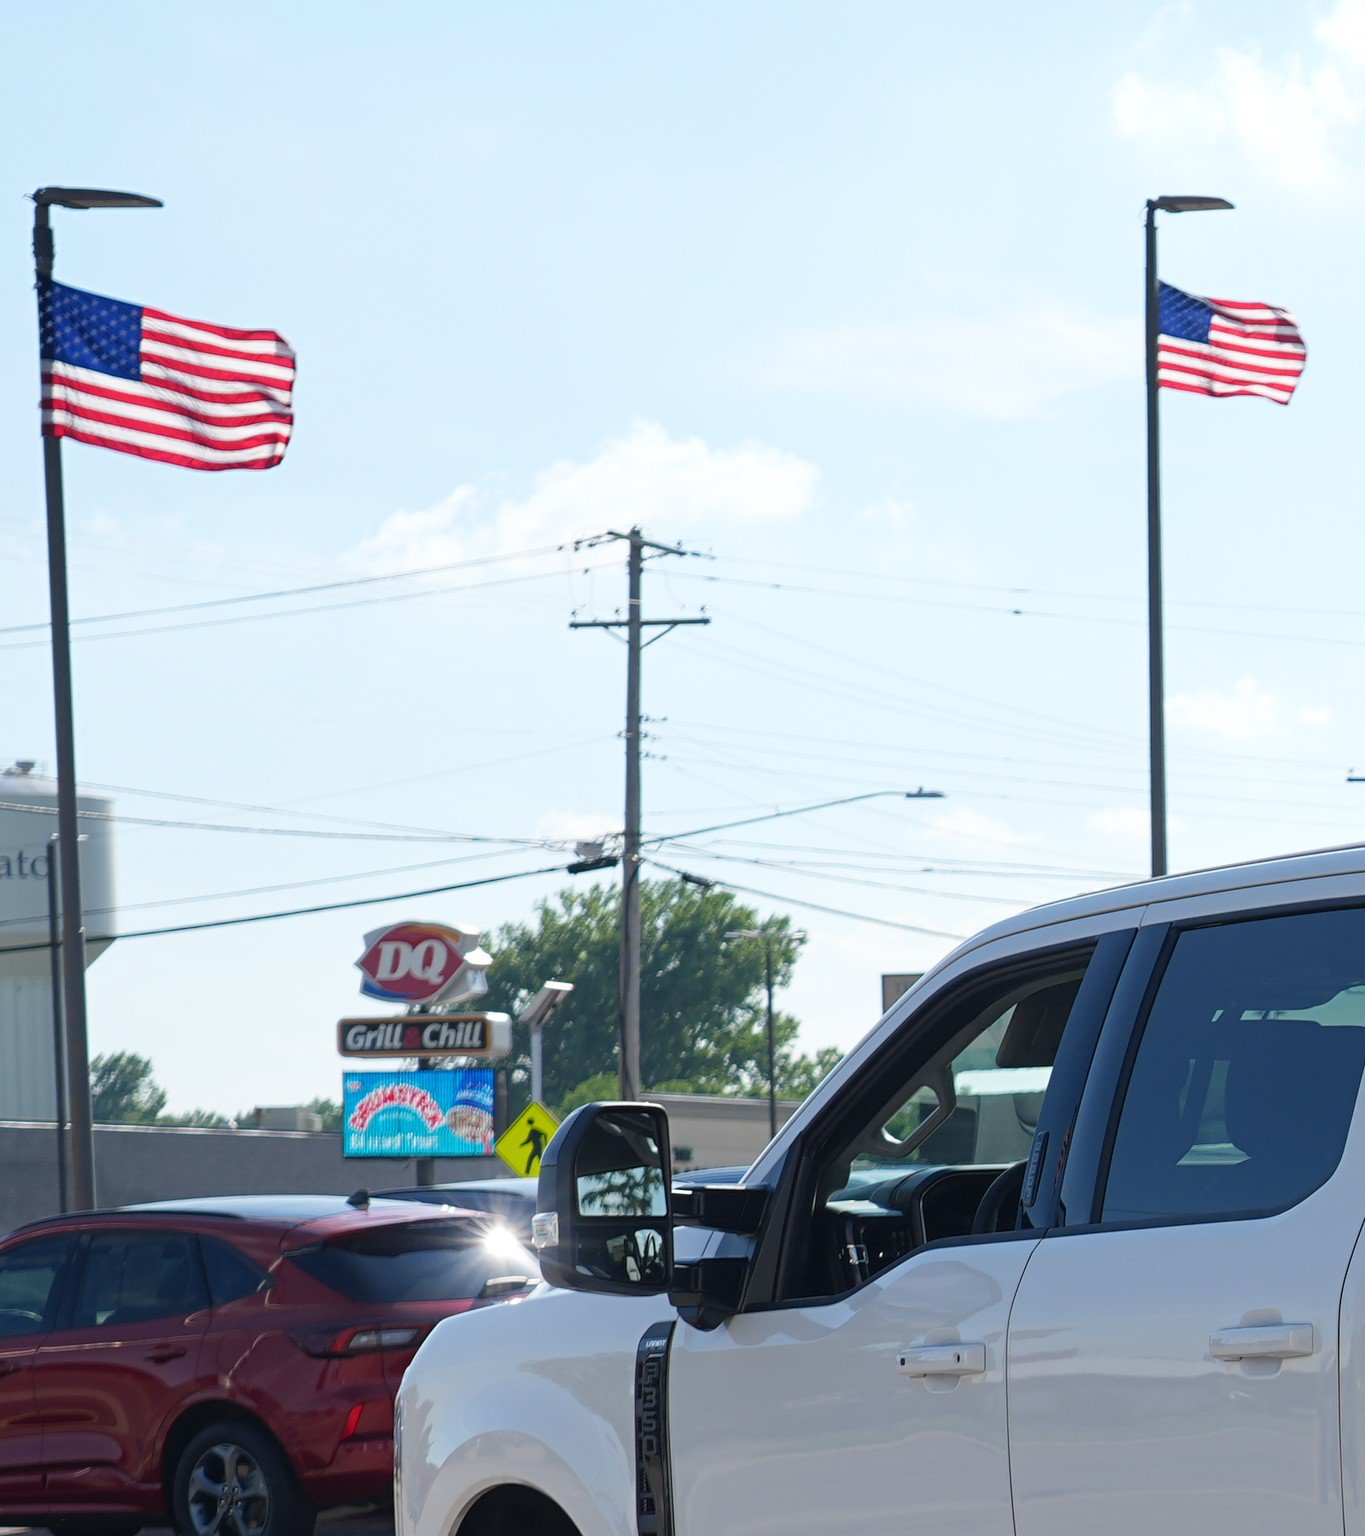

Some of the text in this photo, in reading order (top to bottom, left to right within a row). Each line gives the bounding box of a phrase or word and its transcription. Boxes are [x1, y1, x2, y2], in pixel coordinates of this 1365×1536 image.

[375, 939, 447, 985] DQ
[345, 1023, 403, 1050] Grill
[422, 1021, 482, 1049] Chill
